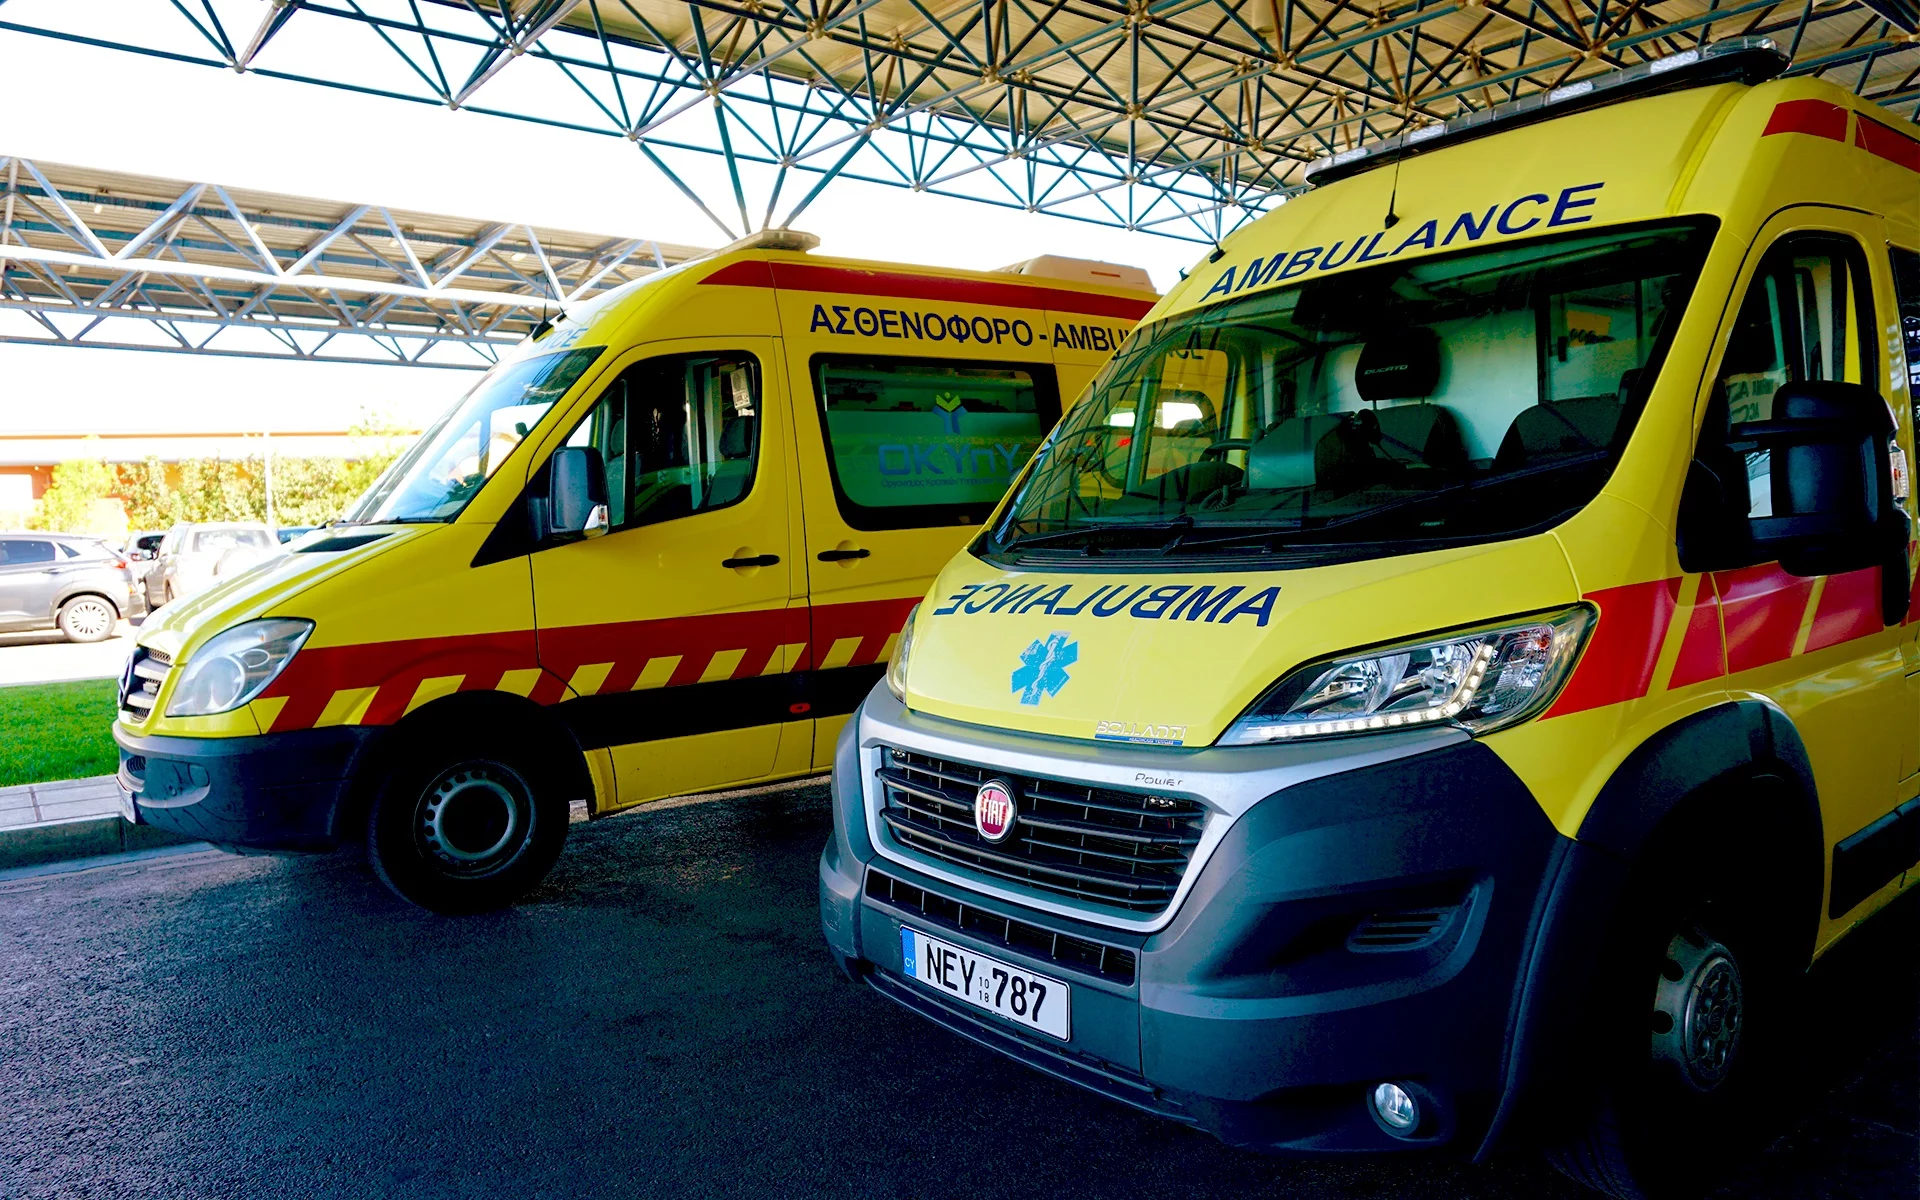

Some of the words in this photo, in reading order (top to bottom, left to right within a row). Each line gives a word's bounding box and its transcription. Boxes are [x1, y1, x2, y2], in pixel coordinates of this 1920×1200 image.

[1198, 182, 1605, 303] AMBULANCE
[810, 304, 1034, 347] ΑΣΘΕΝΟΦΟΡΟ
[982, 798, 1006, 826] FIAT
[904, 957, 915, 968] CY
[926, 943, 975, 996] NEY
[992, 967, 1047, 1022] 787
[978, 976, 990, 989] 10
[978, 990, 990, 1003] 18
